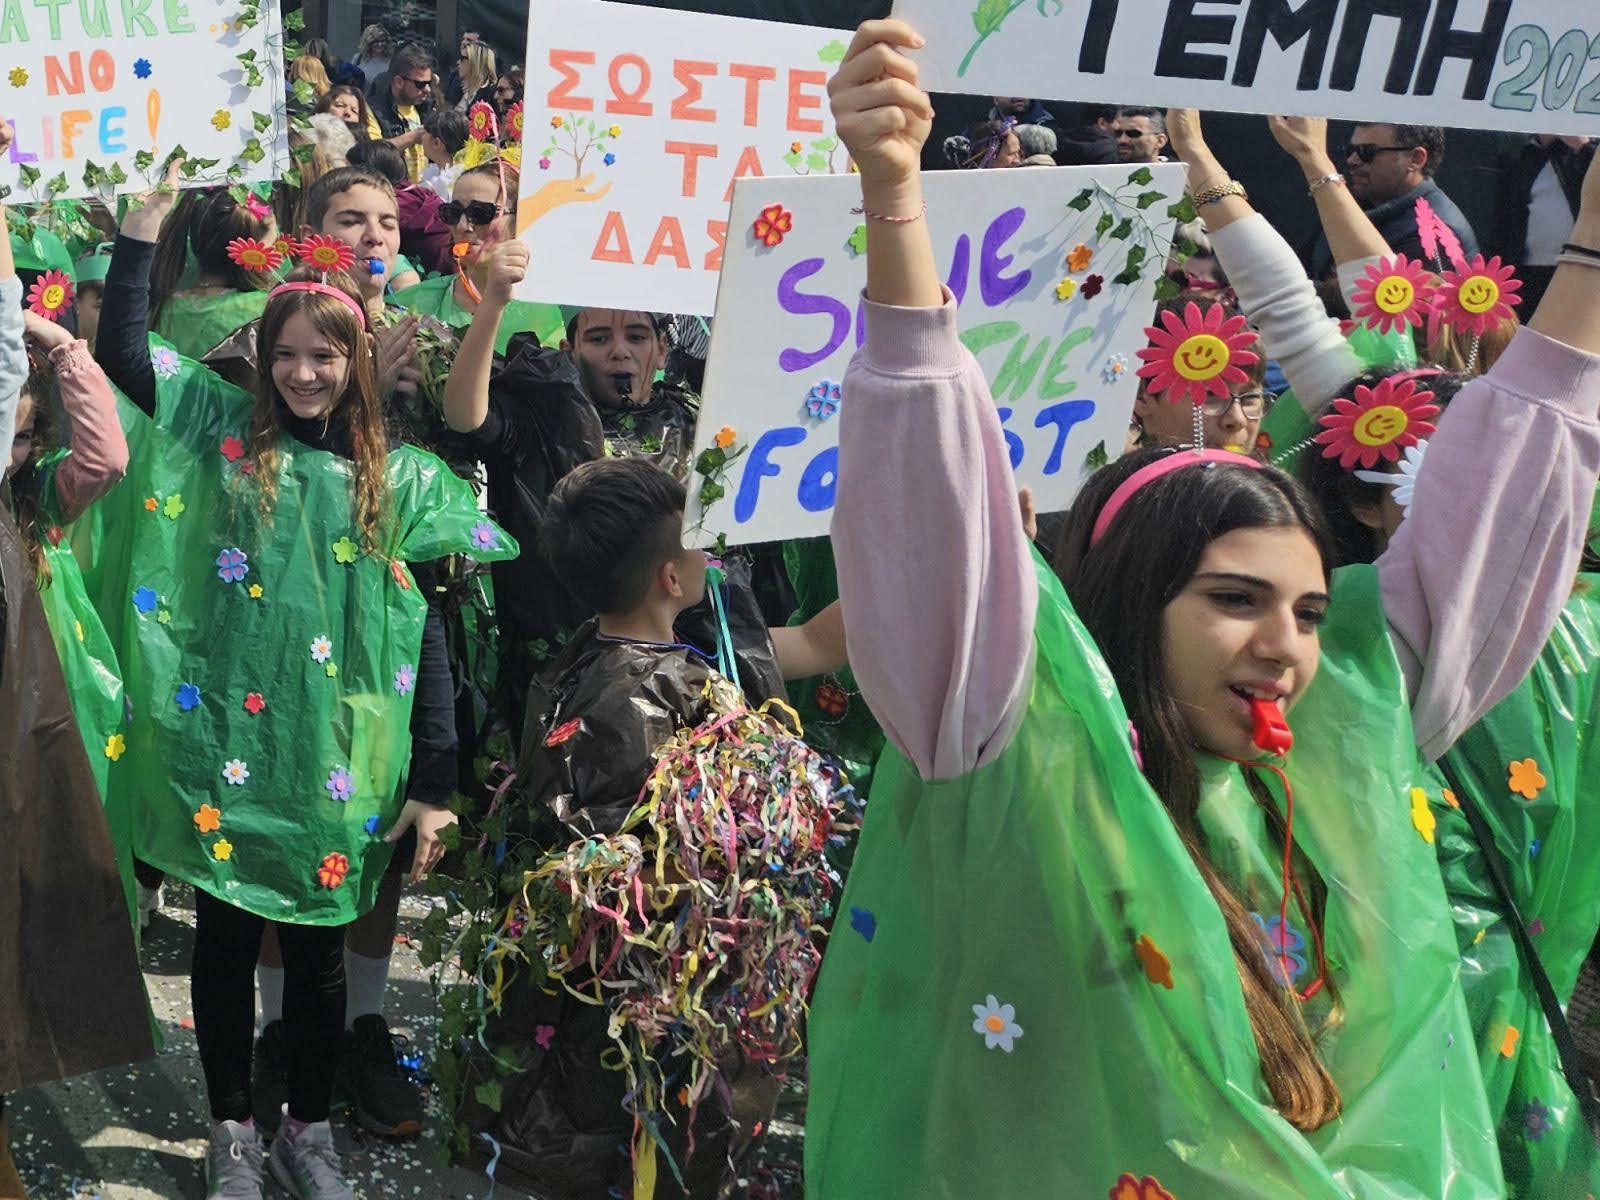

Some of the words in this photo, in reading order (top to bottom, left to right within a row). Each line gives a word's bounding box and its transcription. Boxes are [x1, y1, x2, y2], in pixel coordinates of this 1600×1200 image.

[43, 48, 115, 96] NO
[546, 47, 827, 134] ΣΩΣΤΕ
[776, 206, 1032, 373] SE
[734, 399, 1096, 524] FOT
